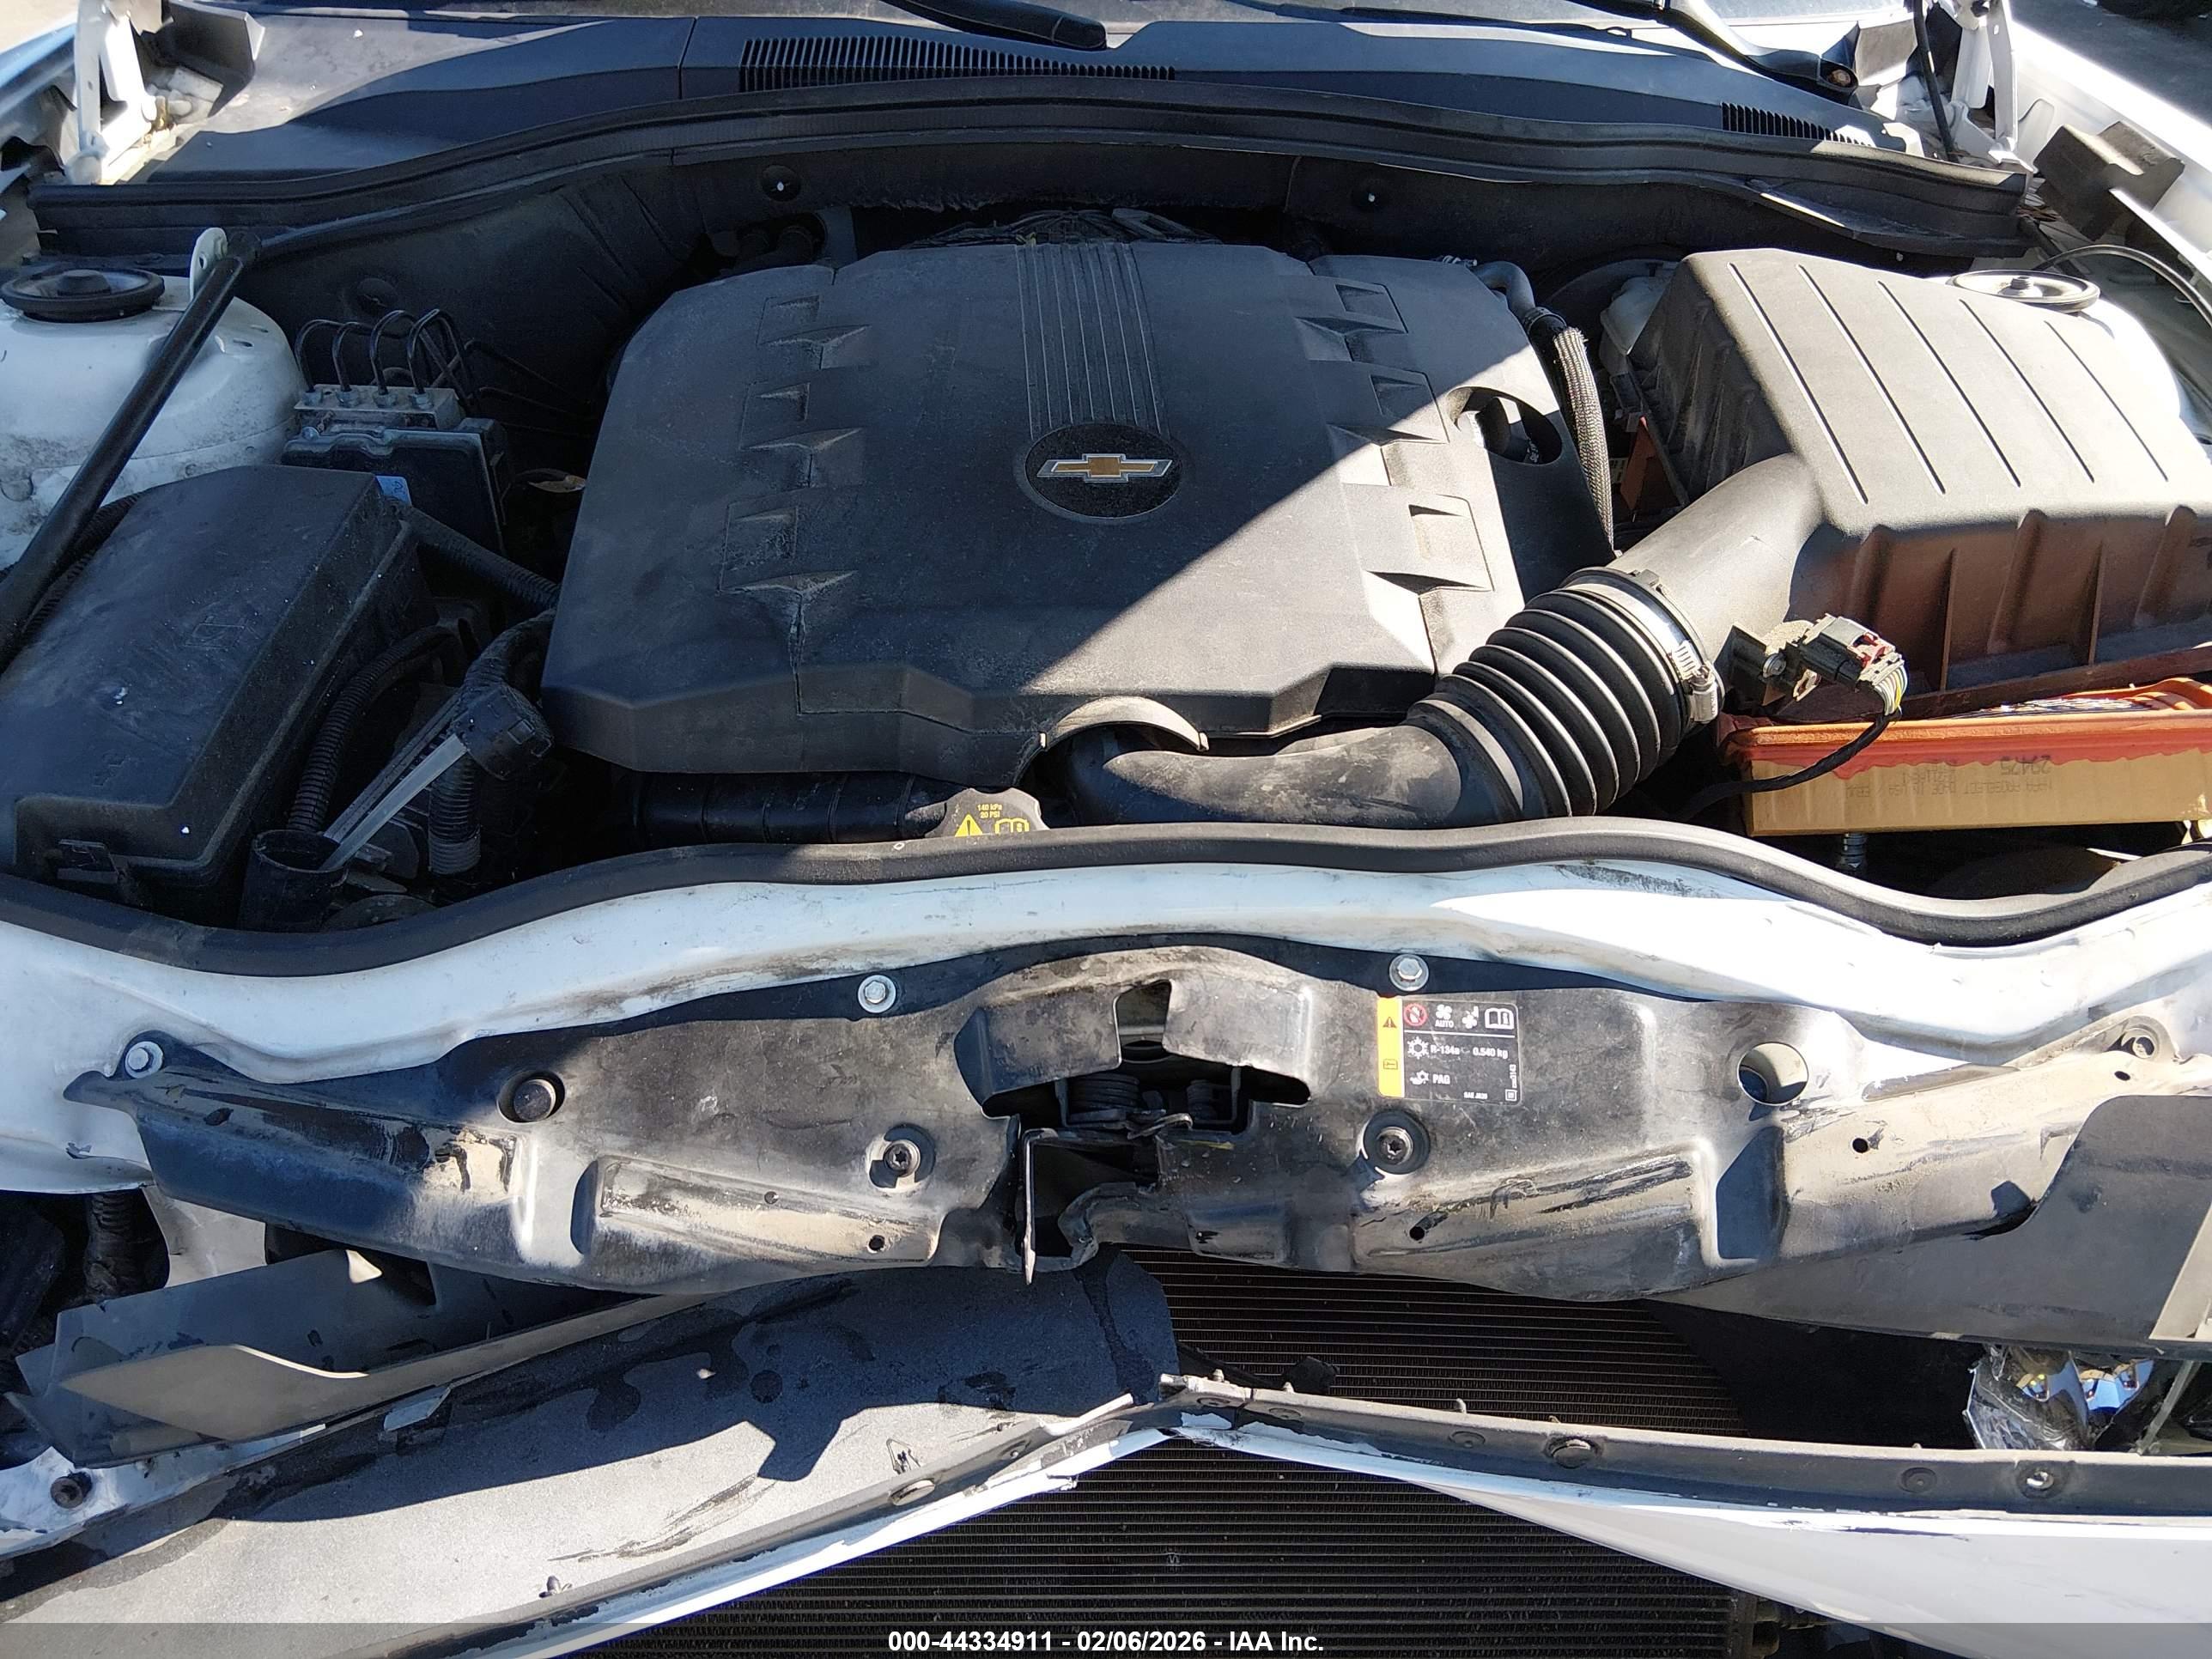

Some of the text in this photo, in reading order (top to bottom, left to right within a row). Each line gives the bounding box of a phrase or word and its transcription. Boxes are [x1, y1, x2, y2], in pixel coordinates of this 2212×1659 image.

[990, 803, 1003, 811] kPa
[980, 811, 989, 819] 20
[1435, 1018, 1454, 1029] AUTO
[1430, 1043, 1460, 1055] R-134a
[1497, 1048, 1509, 1060] kg
[1432, 1073, 1451, 1085] PAG
